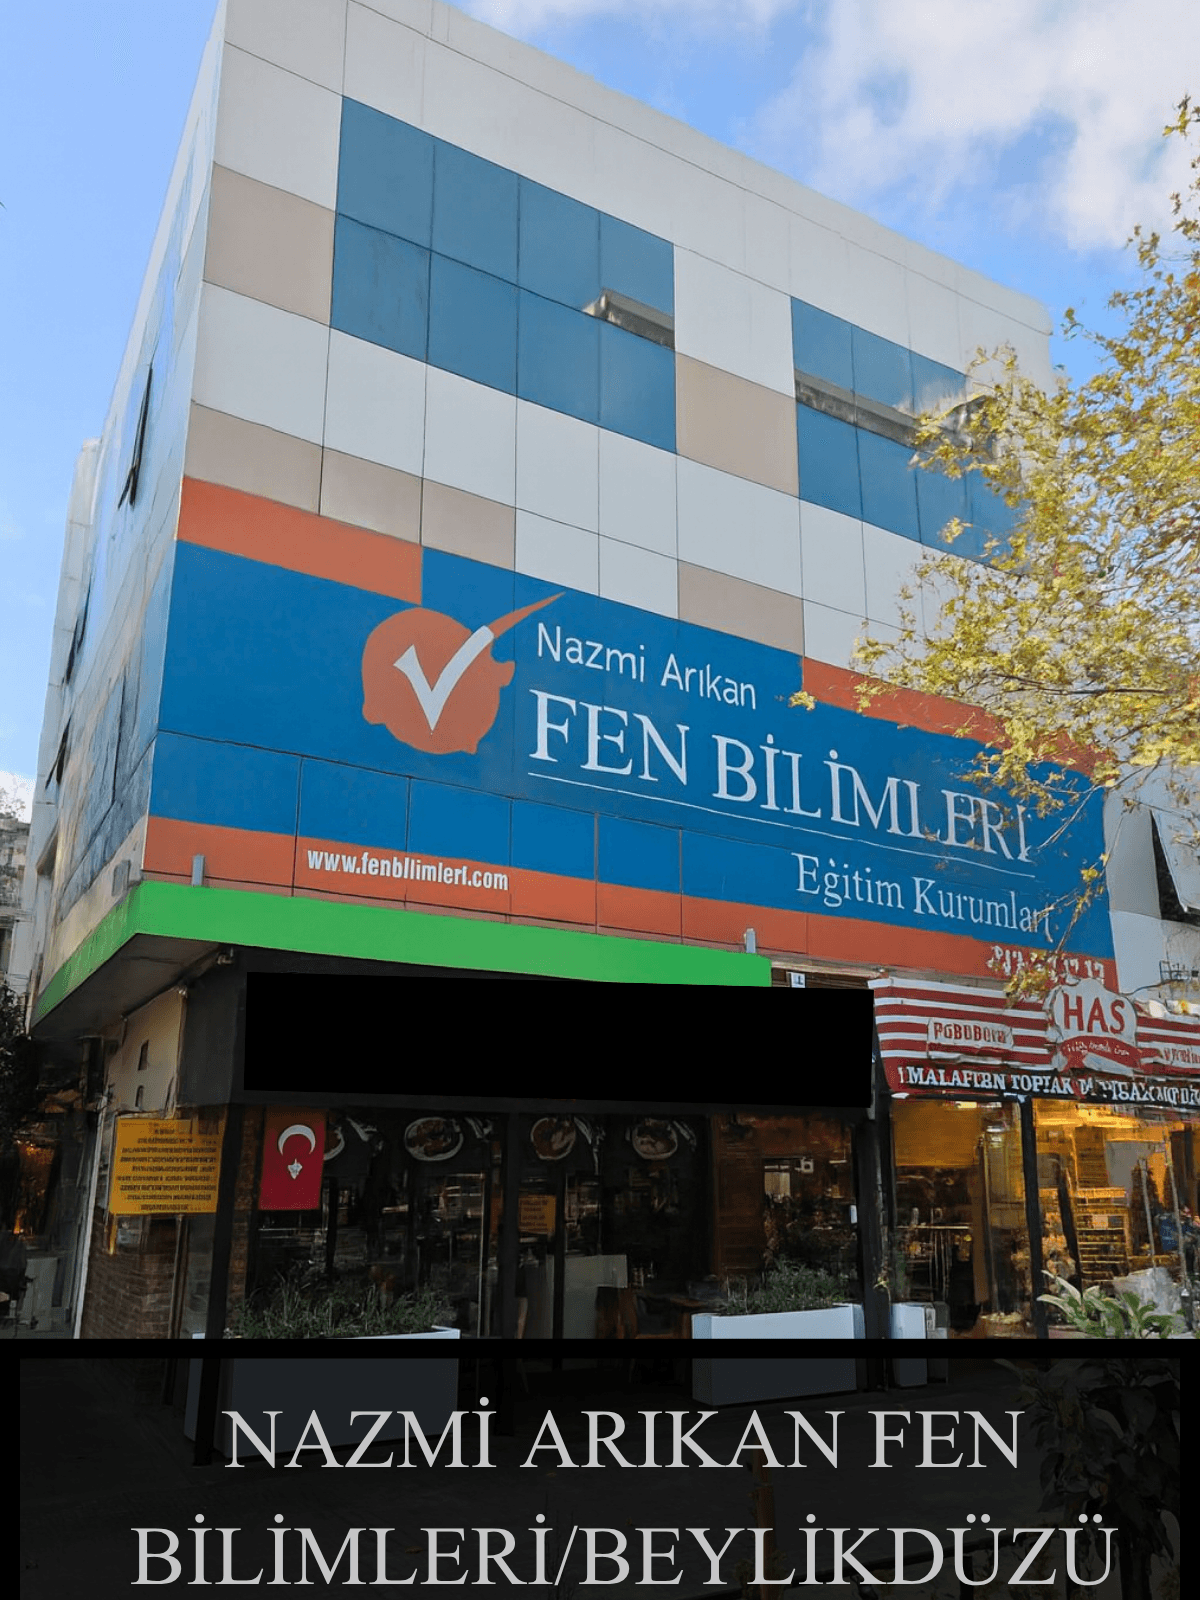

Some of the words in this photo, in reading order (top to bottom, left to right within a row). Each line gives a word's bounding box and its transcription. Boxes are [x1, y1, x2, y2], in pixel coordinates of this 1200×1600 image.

[537, 622, 645, 683] Nazmi
[660, 653, 757, 710] Arıkan
[528, 688, 690, 786] FEN
[791, 852, 905, 908] Eğitim
[1063, 992, 1126, 1034] HAS
